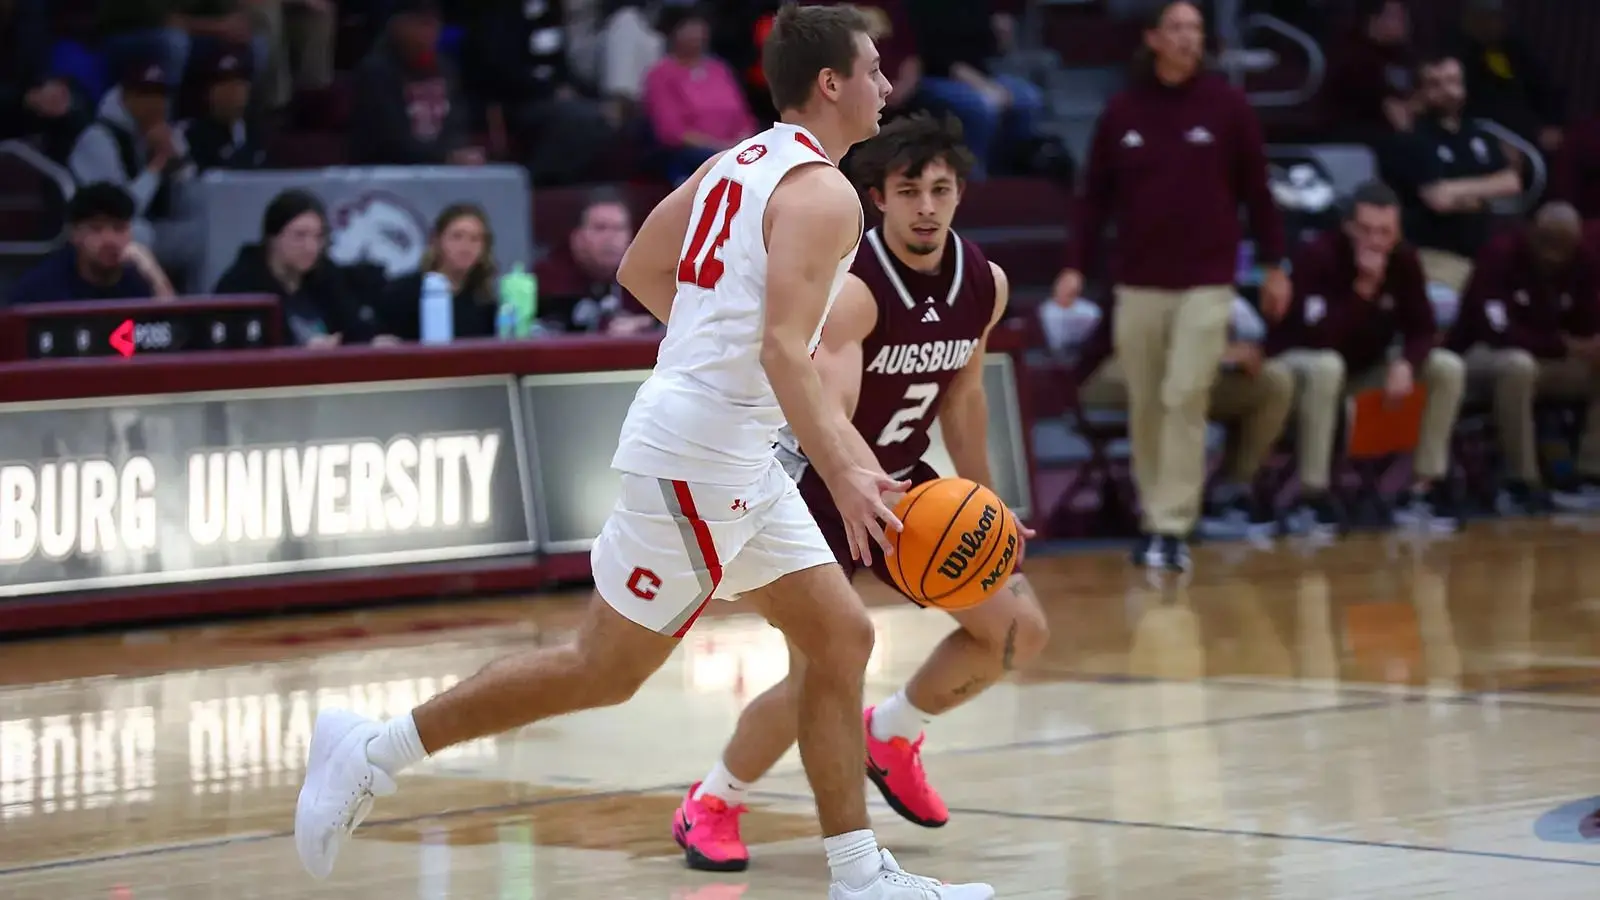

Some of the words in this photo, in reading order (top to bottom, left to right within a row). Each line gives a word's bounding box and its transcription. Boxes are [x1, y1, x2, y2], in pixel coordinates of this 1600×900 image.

[865, 337, 979, 375] AUGSBUR
[877, 382, 940, 446] 2
[0, 455, 157, 562] BURG
[187, 431, 500, 545] UNIVERSITY
[937, 504, 997, 579] Wilson
[981, 533, 1016, 592] NCAA
[626, 565, 663, 601] C
